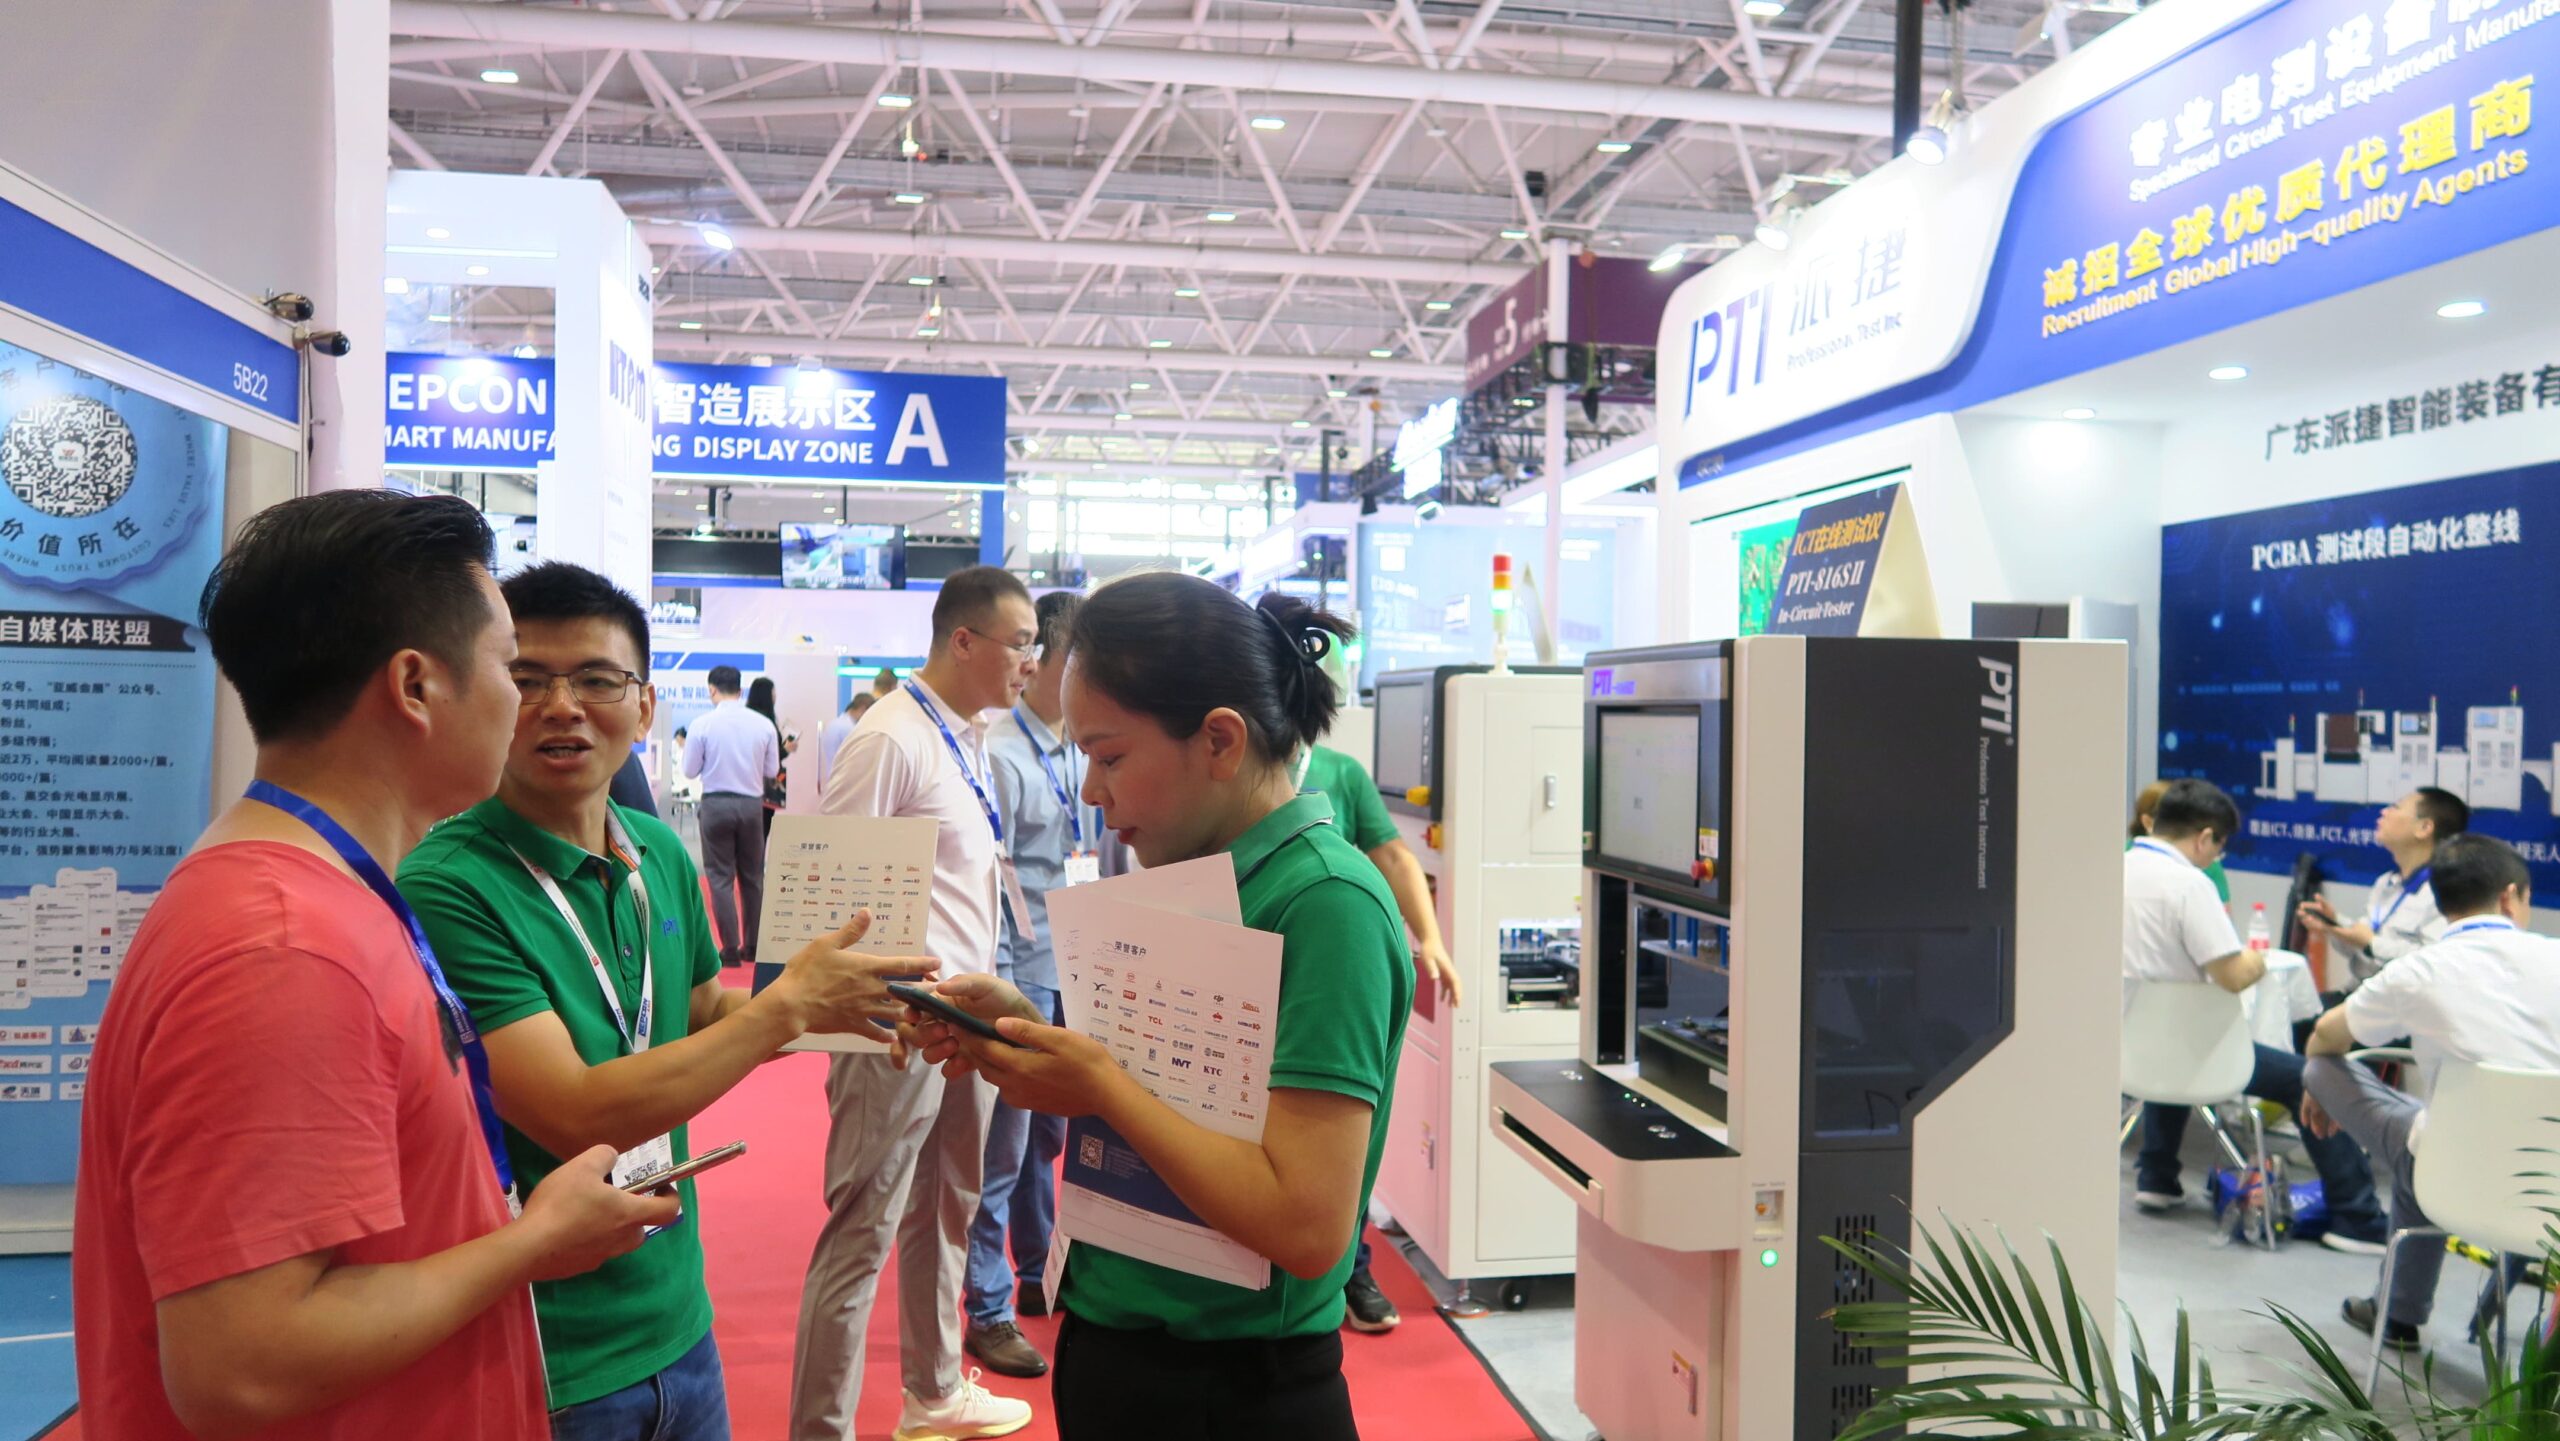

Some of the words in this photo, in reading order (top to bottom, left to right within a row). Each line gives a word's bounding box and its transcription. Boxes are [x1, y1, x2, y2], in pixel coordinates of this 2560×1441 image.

[2129, 143, 2220, 202] Specialized
[2224, 113, 2286, 160] Circuit
[2289, 91, 2336, 129] Test
[2340, 34, 2458, 109] Equipment
[2043, 73, 2534, 308] 诚招全球优质代理商
[2042, 278, 2158, 338] Recruitment
[2164, 248, 2238, 294] Global
[2240, 191, 2408, 268] High-quality
[2411, 149, 2529, 209] Agents
[233, 362, 268, 402] 5B22
[693, 436, 800, 462] DISPLAY
[803, 440, 873, 464] ZONE
[885, 393, 949, 467] A
[2251, 538, 2313, 571] PCBA
[2315, 507, 2521, 565] 测试段自动化整线
[0, 616, 152, 646] 自媒体联盟
[1977, 656, 2013, 735] PTI
[1978, 797, 1989, 822] Test
[1977, 825, 1989, 890] Instrument
[1147, 1015, 1163, 1026] TCL
[1171, 1057, 1191, 1069] NVT
[1203, 1065, 1223, 1077] KTC
